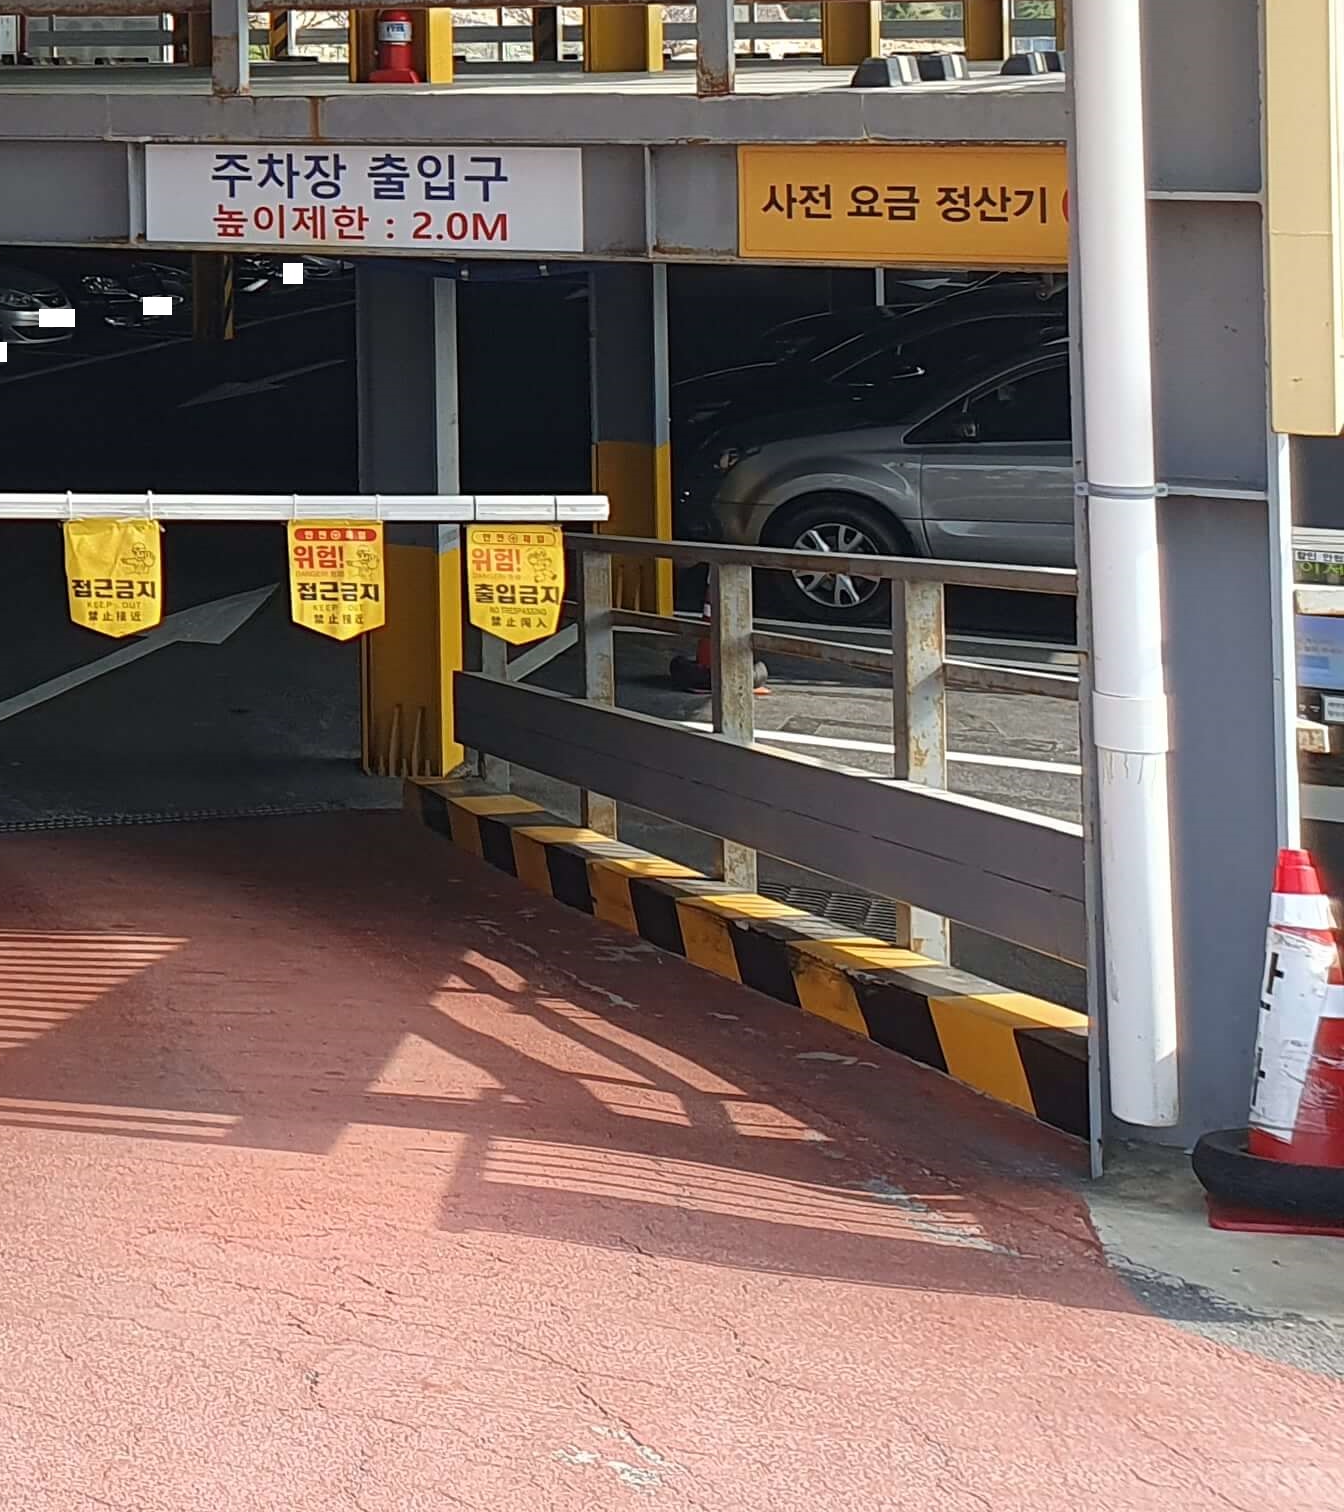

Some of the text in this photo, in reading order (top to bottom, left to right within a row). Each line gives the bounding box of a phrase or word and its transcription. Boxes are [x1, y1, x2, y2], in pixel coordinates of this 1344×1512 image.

[209, 150, 511, 204] 주차장 출입구
[760, 180, 1049, 225] 사전 요금 정산기
[211, 204, 370, 243] 높이제한
[411, 209, 509, 243] 2.0M
[293, 545, 345, 570] 위험!
[471, 547, 521, 572] 위험!
[71, 578, 157, 600] 접근금지
[296, 581, 380, 603] 접근금지
[474, 583, 560, 605] 출입금지
